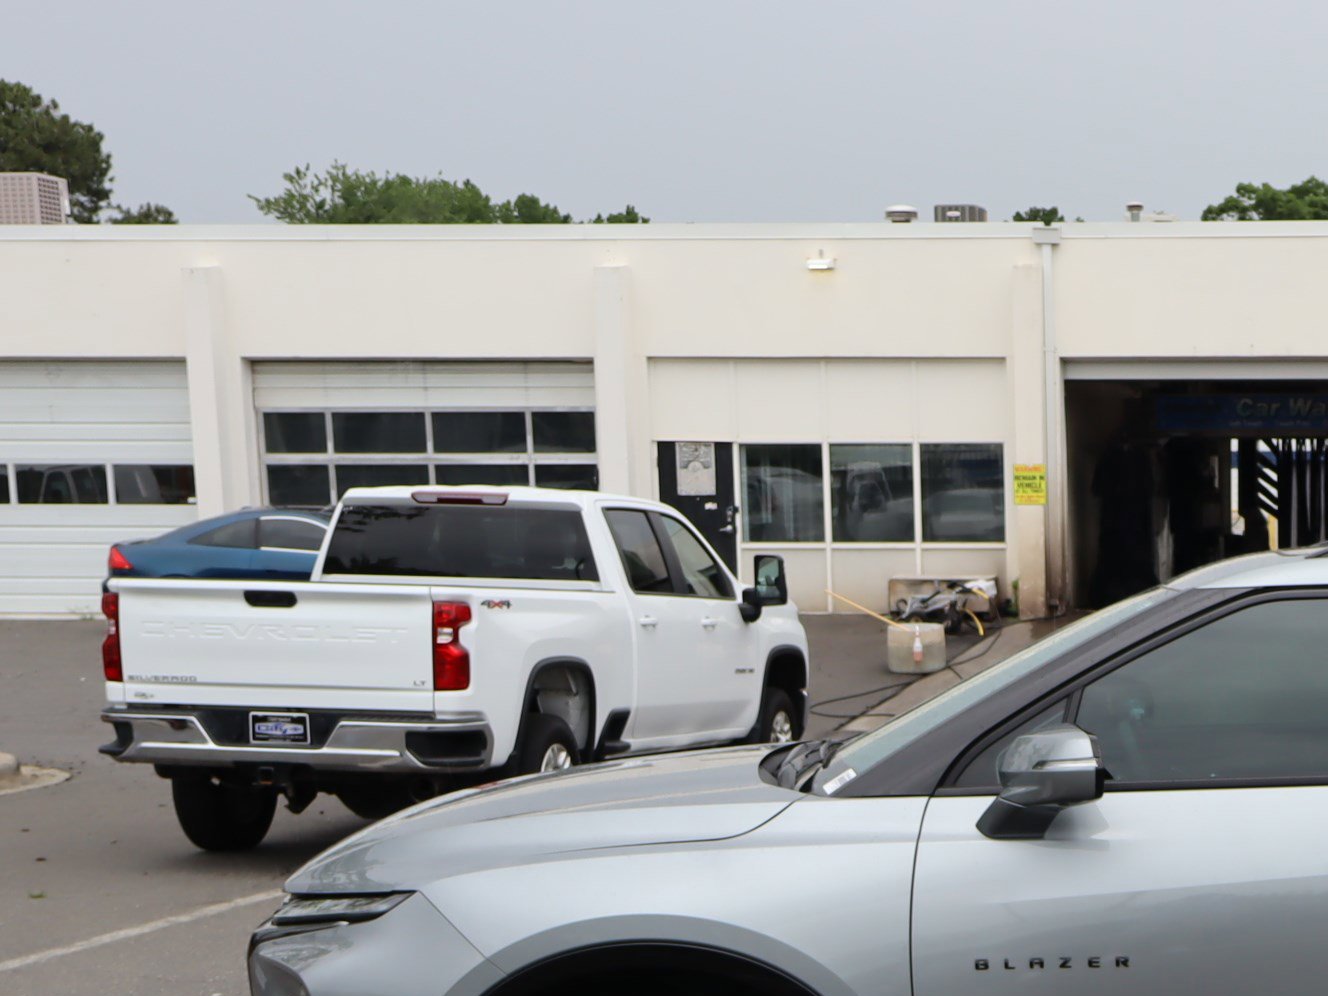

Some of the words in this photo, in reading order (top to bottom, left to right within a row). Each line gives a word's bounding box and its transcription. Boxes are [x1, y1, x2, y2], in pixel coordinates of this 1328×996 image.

[1235, 397, 1281, 417] Car
[139, 620, 409, 644] CHEVROLET
[974, 955, 1130, 971] BLAZER
